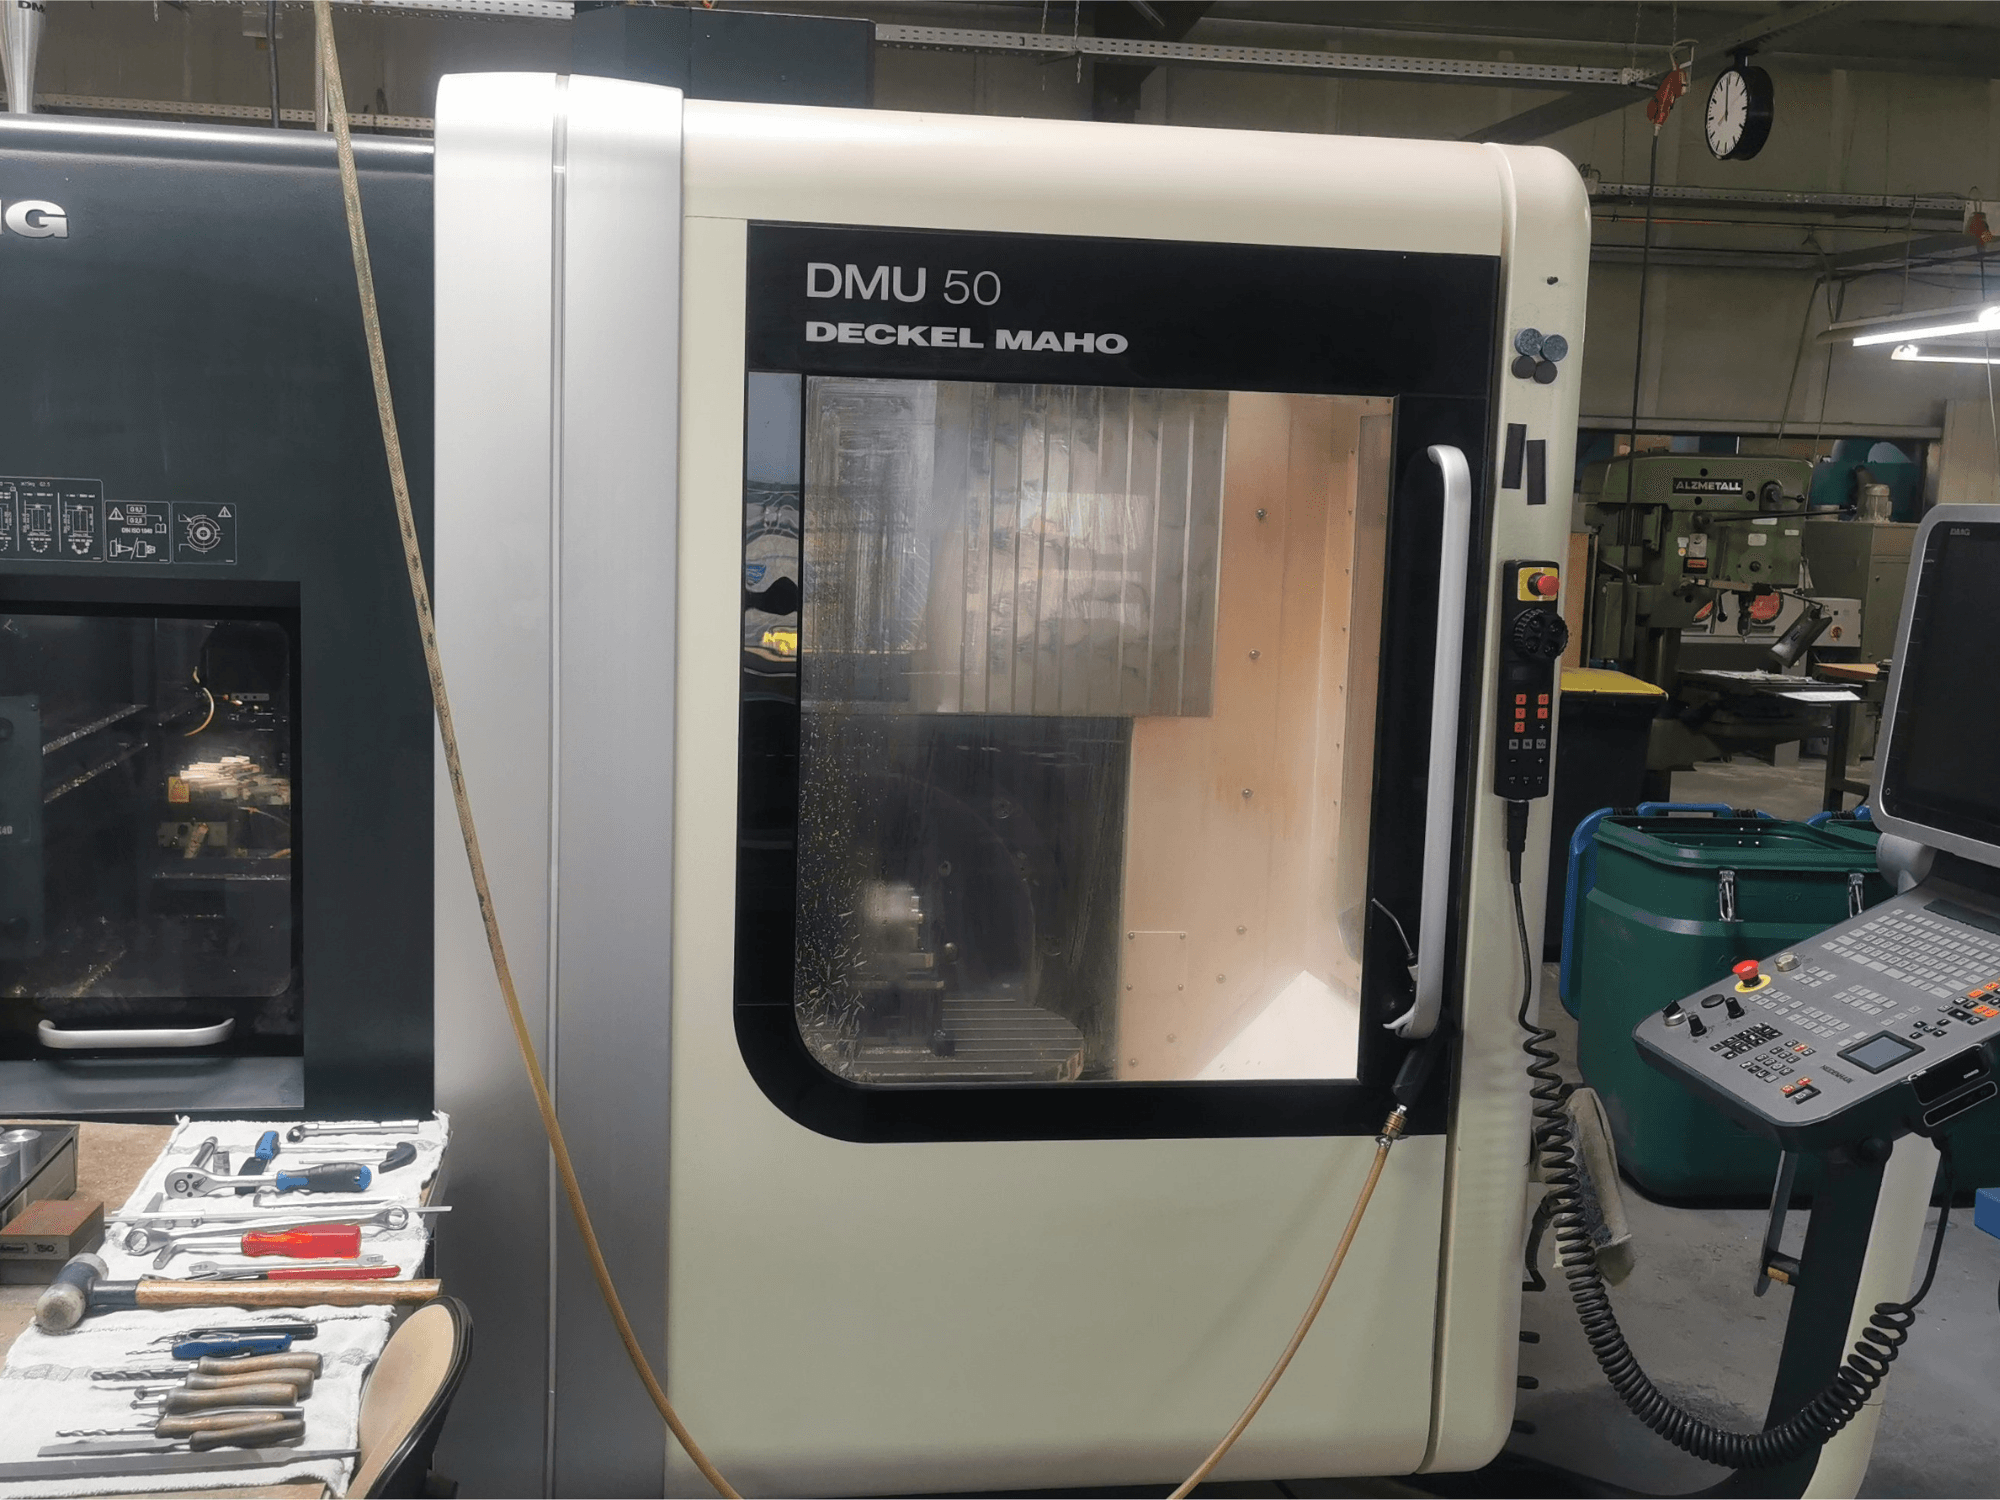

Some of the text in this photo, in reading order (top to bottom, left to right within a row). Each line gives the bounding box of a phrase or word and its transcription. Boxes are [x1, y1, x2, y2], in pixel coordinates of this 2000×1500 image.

[0, 199, 68, 238] G
[806, 262, 1001, 306] DMU 50
[806, 321, 1128, 355] DECKEL MAHO
[1676, 481, 1741, 491] ALZMETALL
